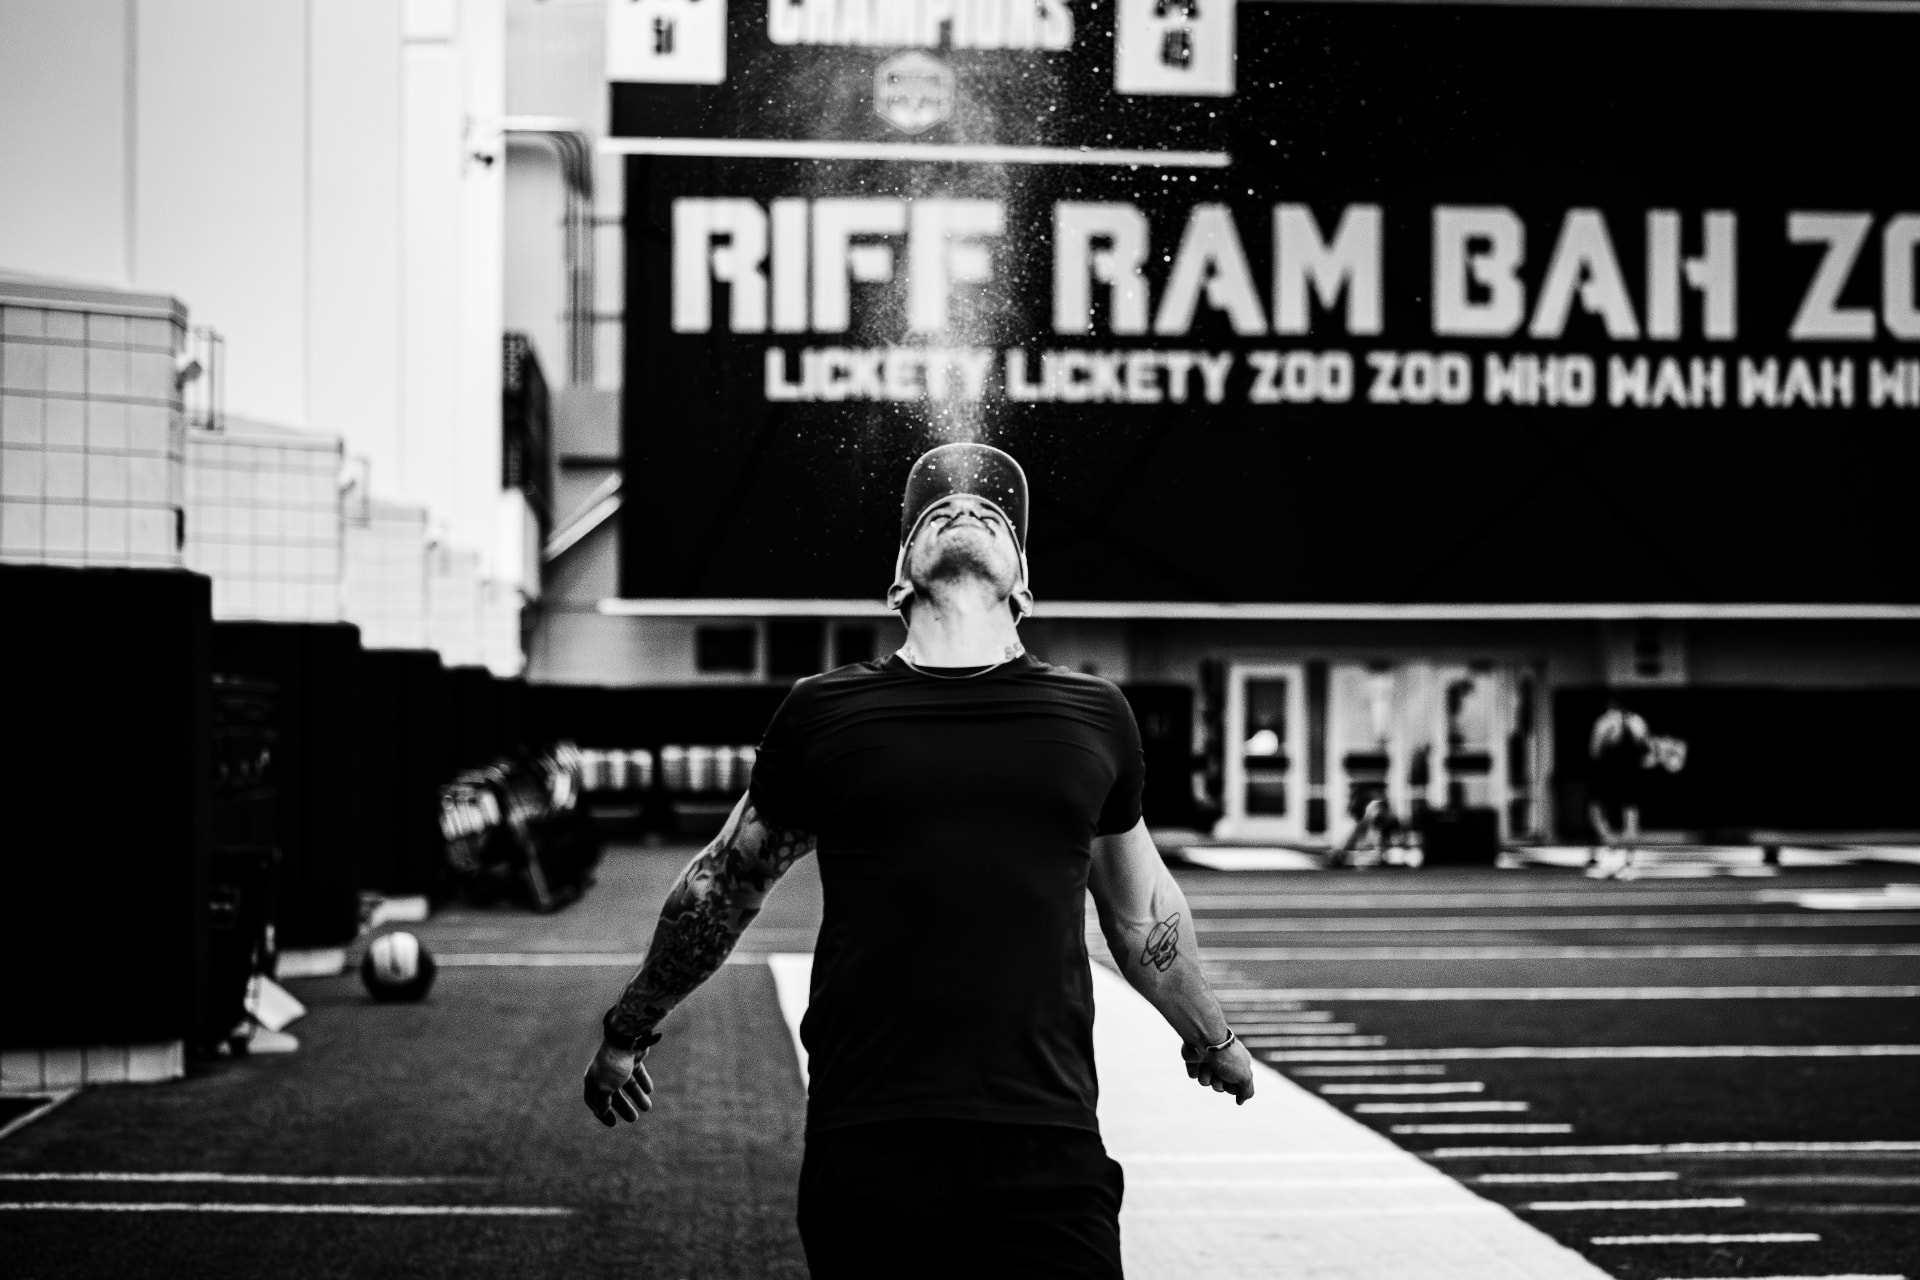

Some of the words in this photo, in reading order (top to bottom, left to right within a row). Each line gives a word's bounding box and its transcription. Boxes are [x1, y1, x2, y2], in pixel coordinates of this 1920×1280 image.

[672, 197, 1003, 334] RIFF
[1054, 201, 1383, 336] RAM
[1432, 206, 1737, 340] BAH
[765, 347, 992, 402] LICKETY
[1005, 349, 1234, 404] LICKETY
[1248, 351, 1354, 404] ZOO
[1367, 351, 1472, 404] ZOO
